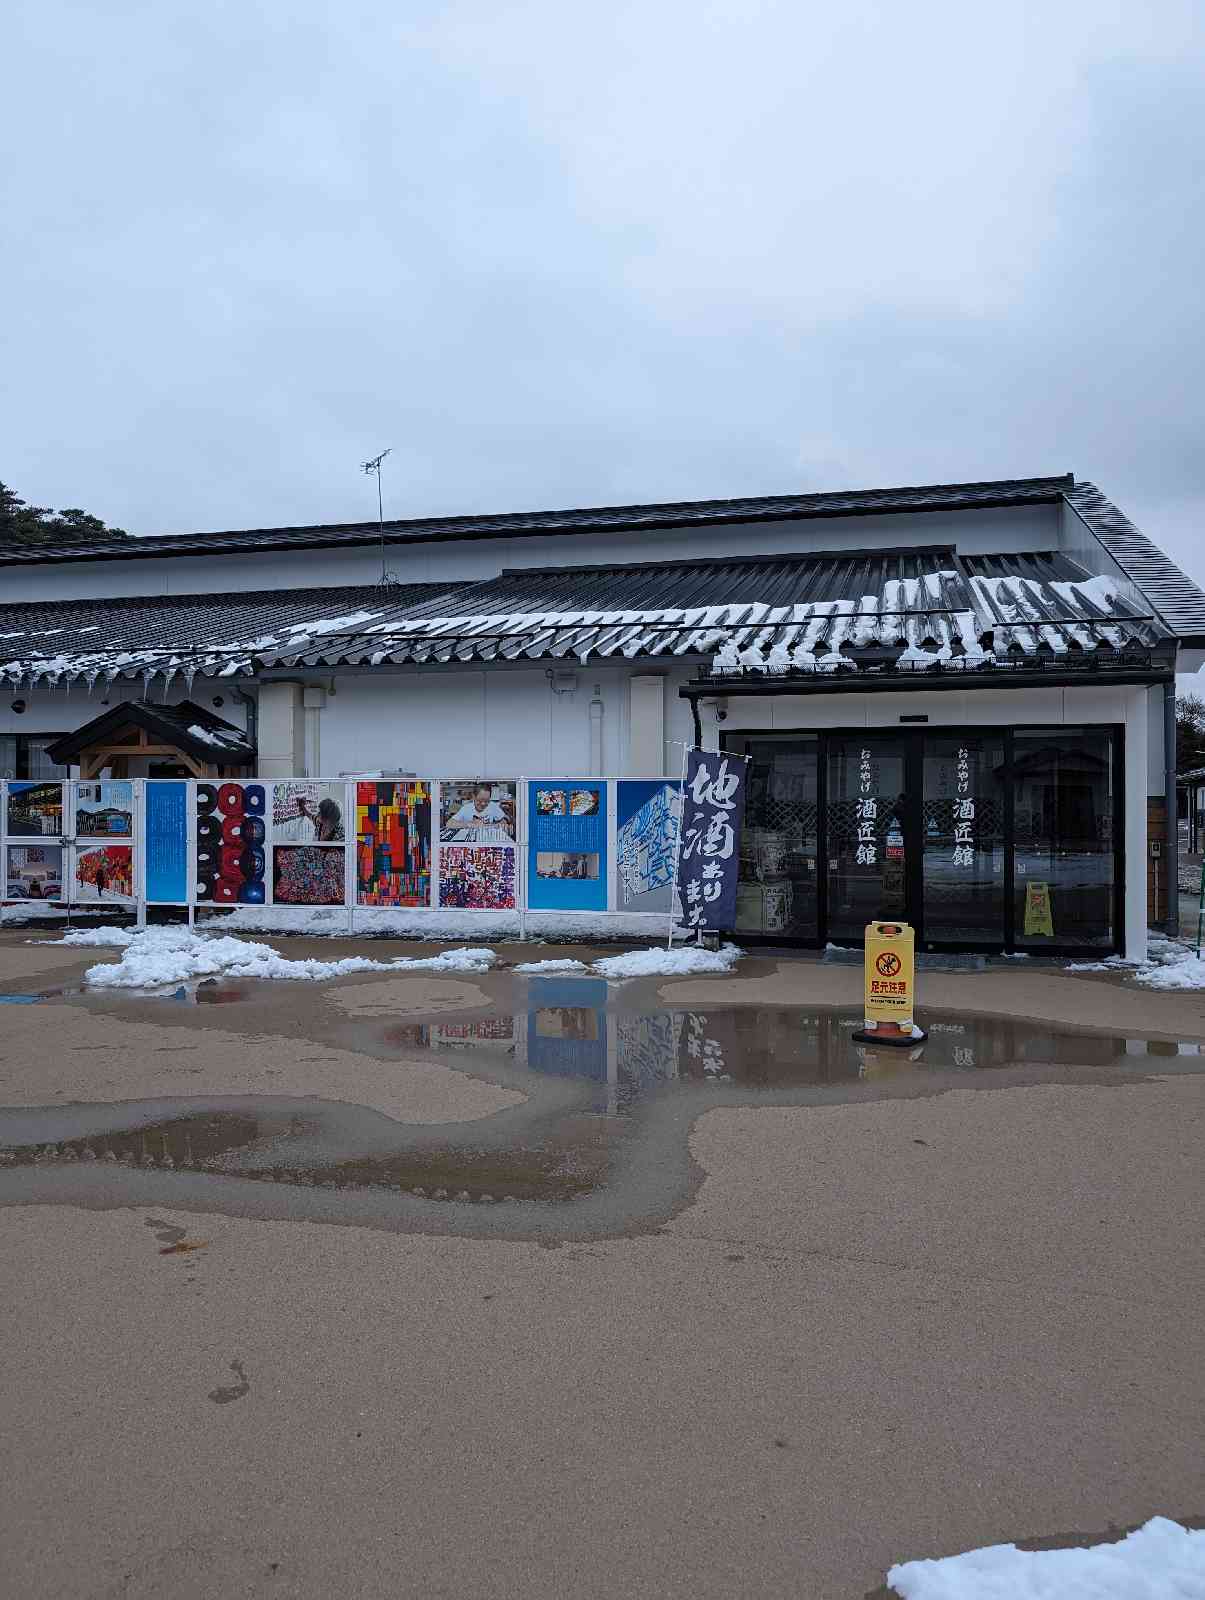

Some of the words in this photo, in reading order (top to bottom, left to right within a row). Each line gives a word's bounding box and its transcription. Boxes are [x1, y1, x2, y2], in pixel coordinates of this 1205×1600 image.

[860, 748, 872, 793] おみやげ
[957, 748, 969, 793] おみやげ
[682, 758, 740, 860] 地酒
[855, 797, 878, 865] 酒匠館
[952, 797, 975, 866] 酒匠館
[871, 980, 907, 995] 足元注意
